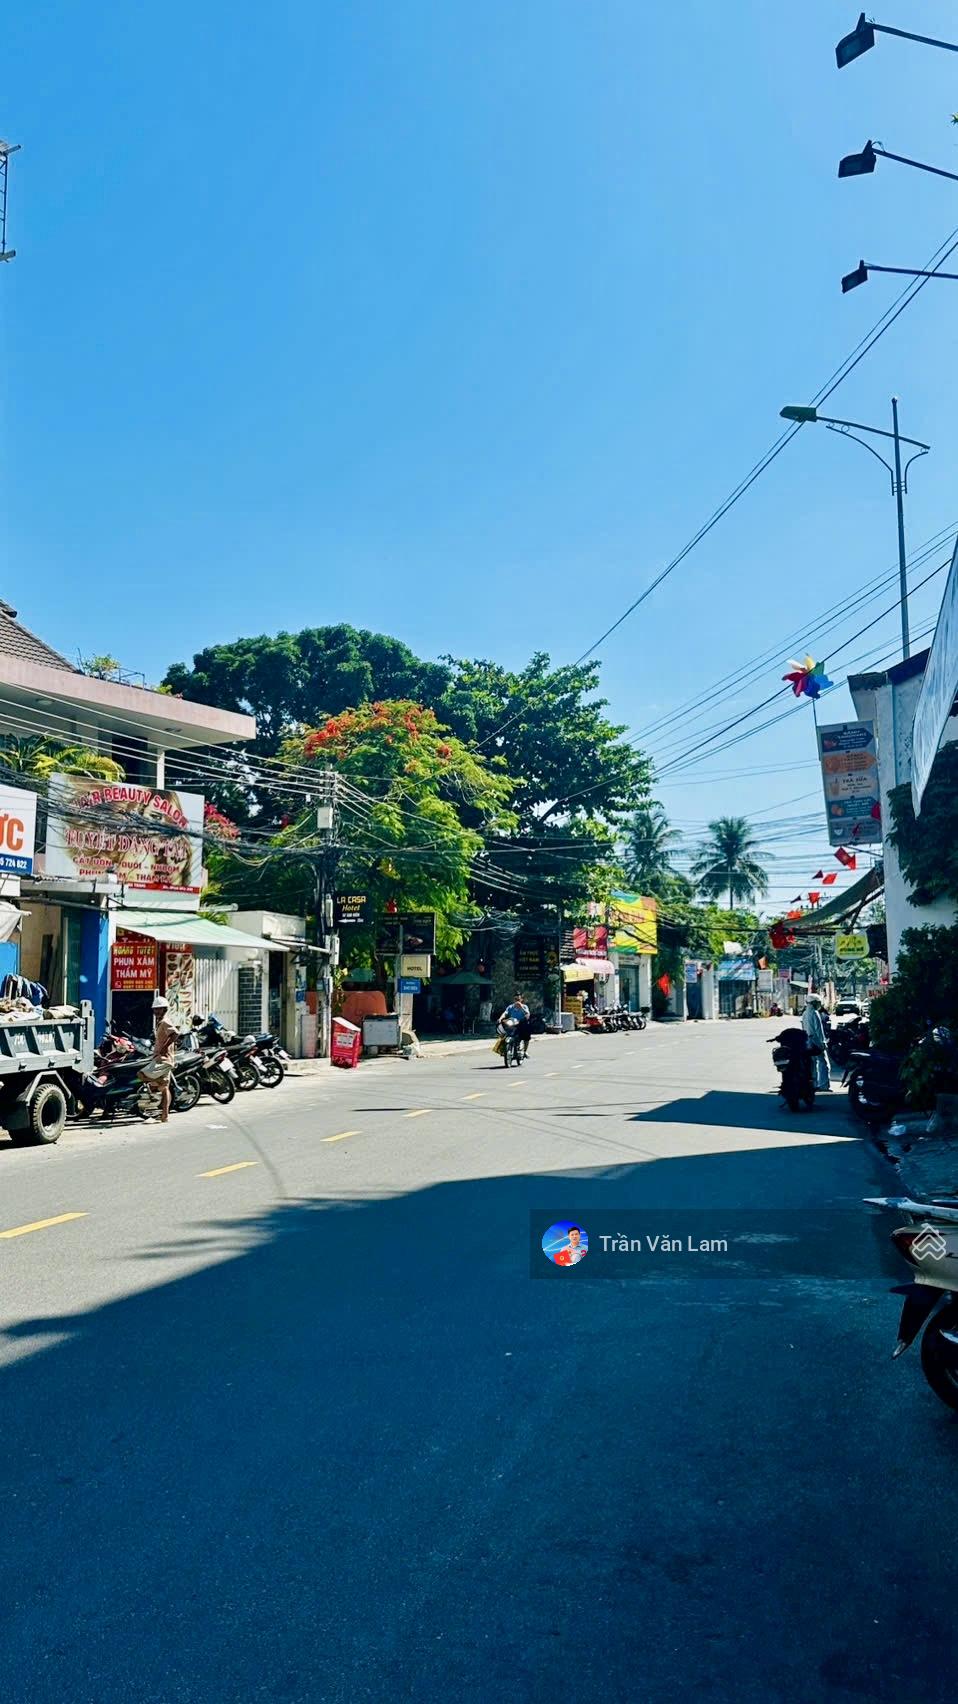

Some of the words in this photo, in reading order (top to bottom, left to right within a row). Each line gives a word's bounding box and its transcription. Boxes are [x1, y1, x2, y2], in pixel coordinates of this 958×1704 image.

[103, 786, 151, 805] BEAUTY
[152, 794, 190, 829] SALON
[336, 896, 346, 904] LA
[347, 895, 367, 904] CASA
[341, 904, 361, 912] Hotel
[113, 957, 134, 966] PHUN
